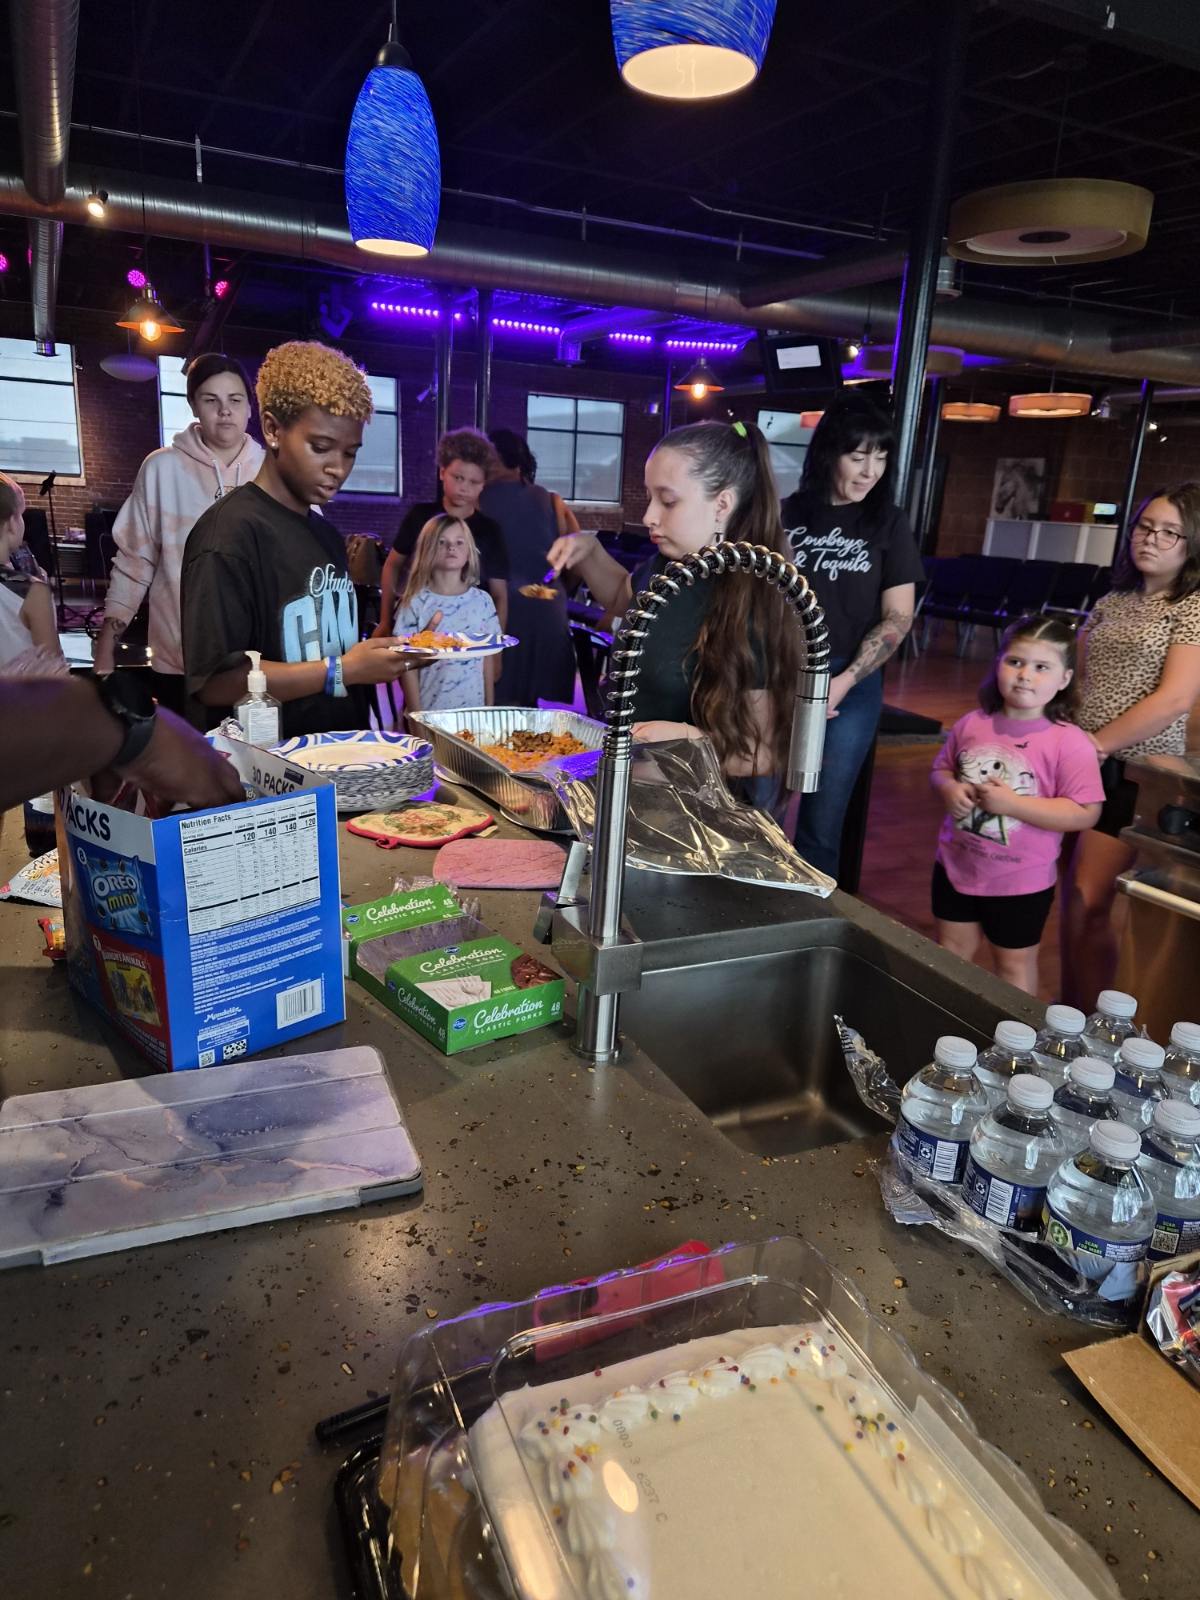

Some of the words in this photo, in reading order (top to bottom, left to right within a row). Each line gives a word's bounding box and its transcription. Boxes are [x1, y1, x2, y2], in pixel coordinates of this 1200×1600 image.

[784, 526, 868, 557] Cowboys
[793, 551, 807, 568] &
[811, 548, 872, 581] Tequila
[181, 818, 212, 830] Nutrition
[213, 814, 232, 823] Facts
[183, 845, 208, 854] Calories
[243, 832, 256, 841] 120
[264, 827, 277, 836] 140
[285, 823, 297, 831] 140
[305, 817, 316, 826] 120
[93, 875, 137, 897] OREO
[107, 891, 137, 912] mini
[366, 898, 434, 921] Celebration
[420, 948, 503, 973] Celebration
[397, 987, 437, 1025] Celebration
[474, 998, 544, 1029] Celebration
[551, 1001, 561, 1012] 48
[474, 1021, 511, 1035] PLASTIC
[516, 1012, 542, 1024] FORKS
